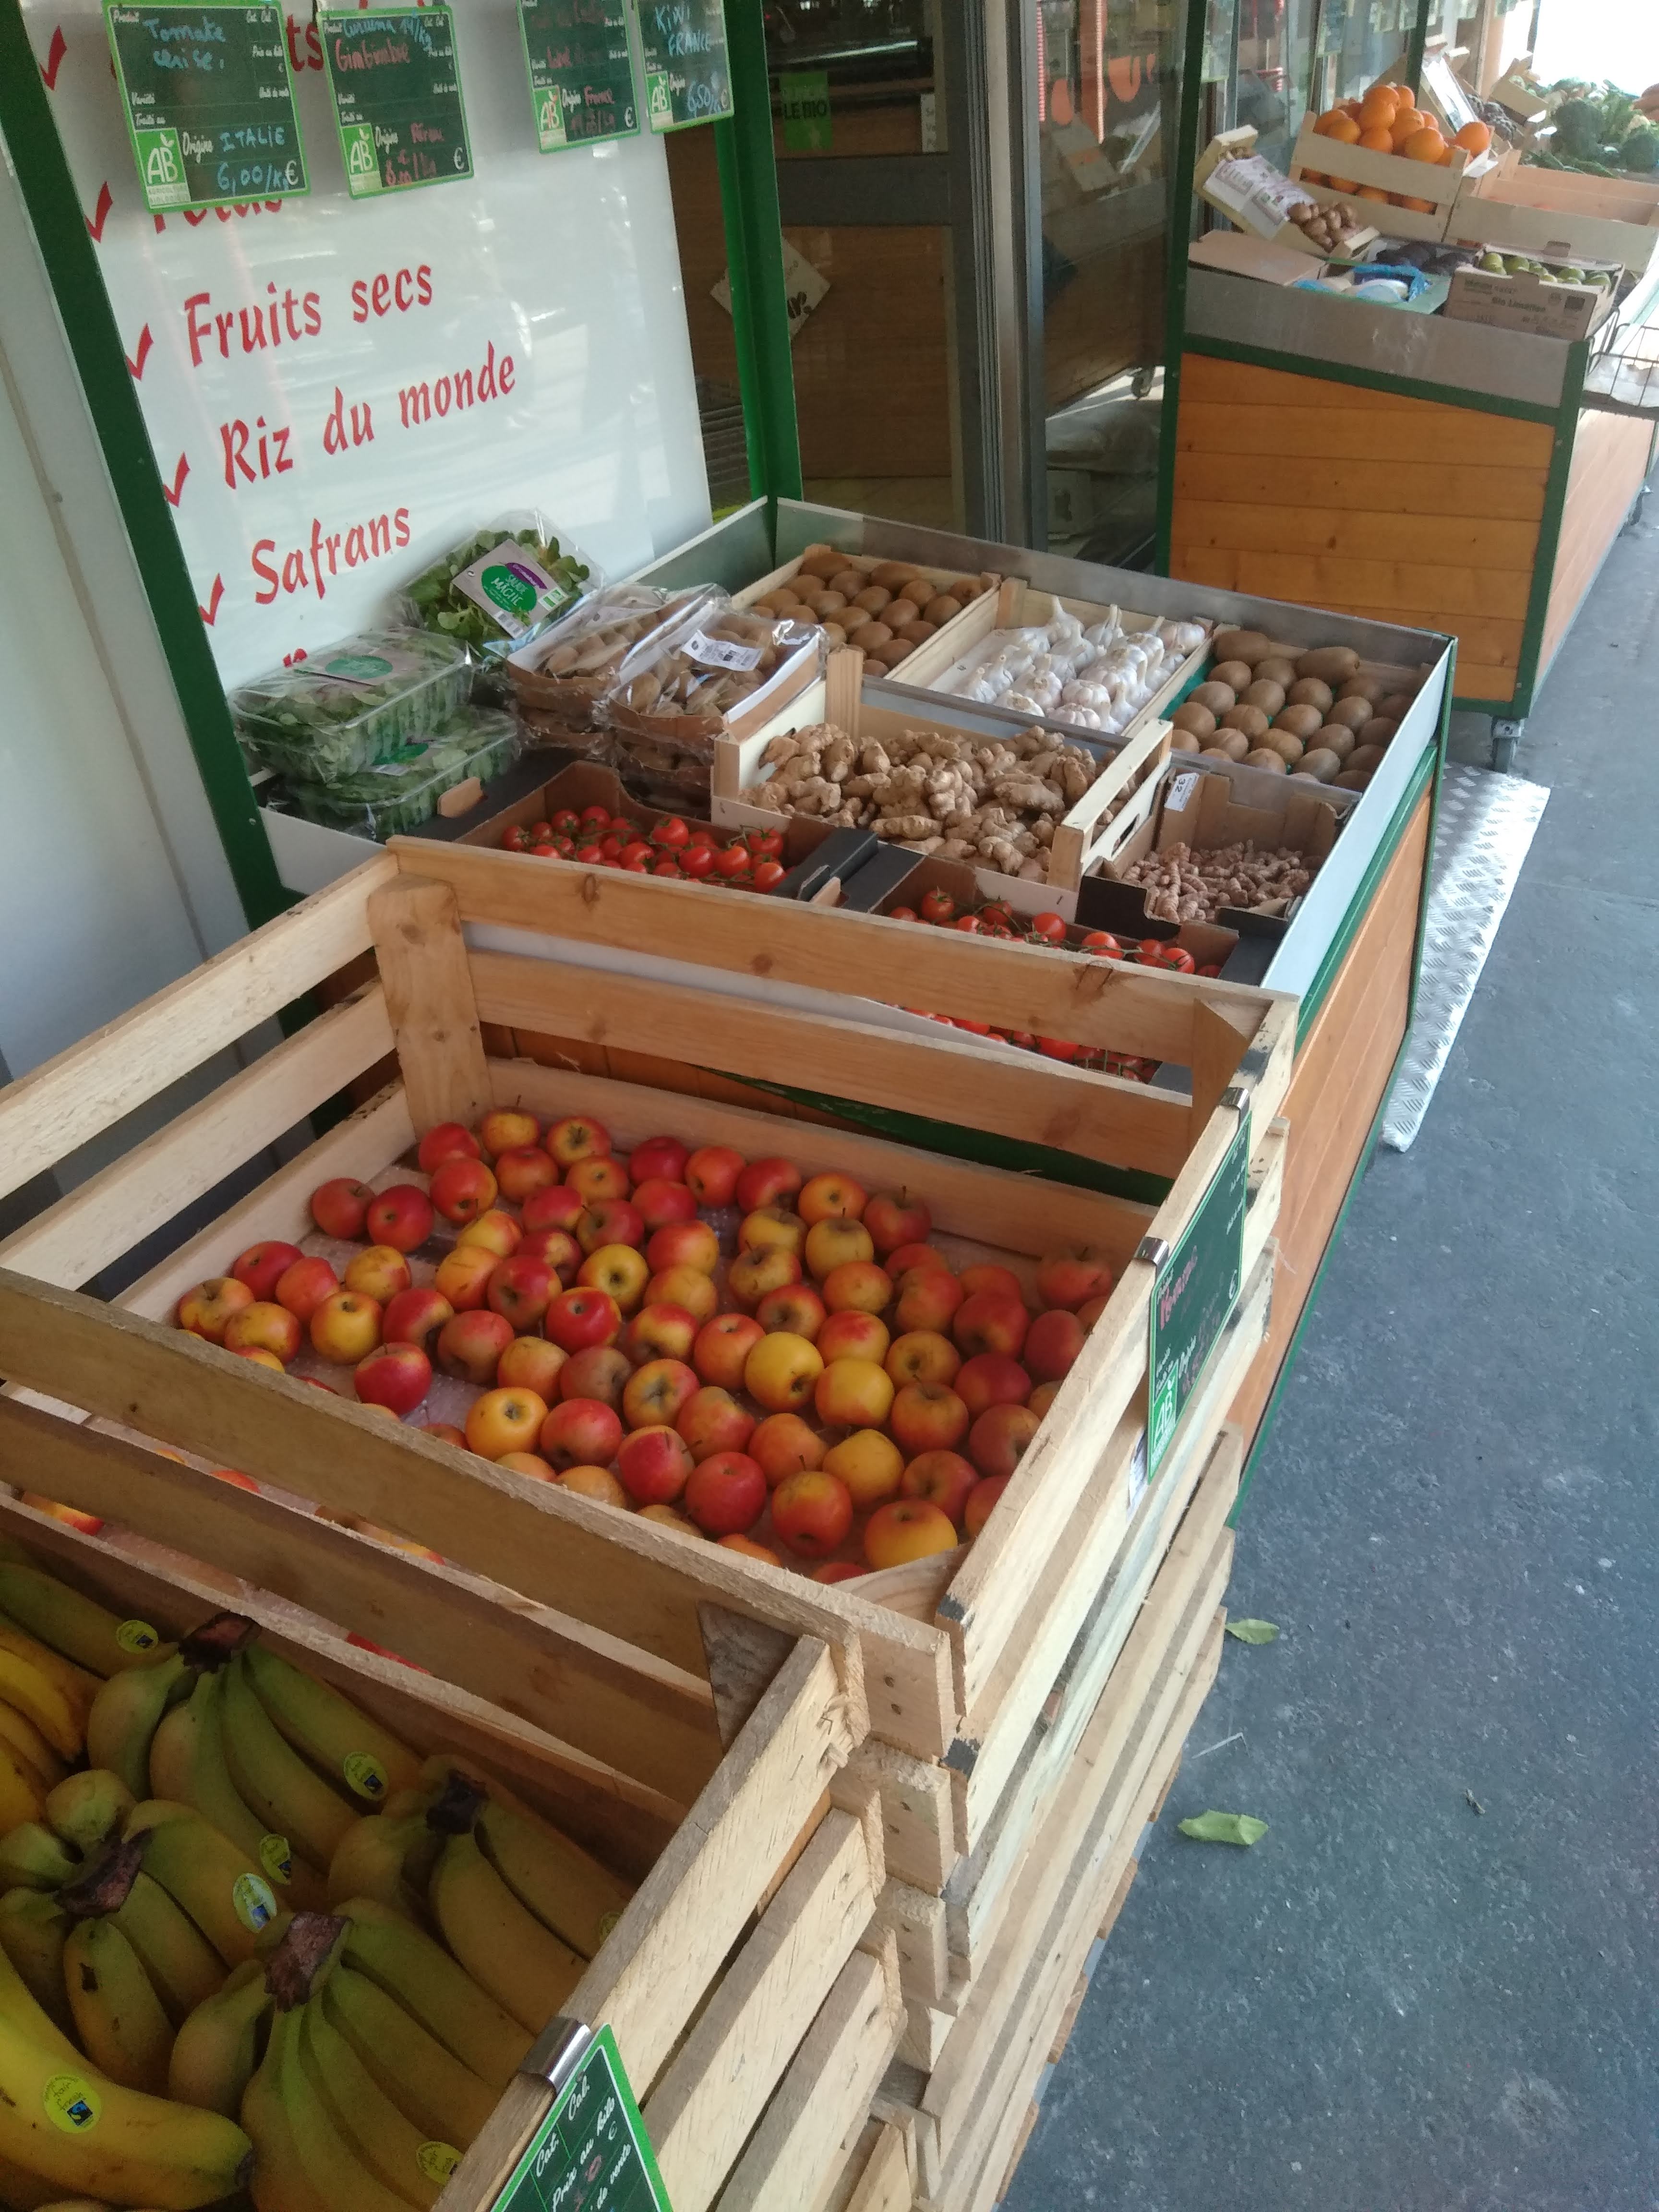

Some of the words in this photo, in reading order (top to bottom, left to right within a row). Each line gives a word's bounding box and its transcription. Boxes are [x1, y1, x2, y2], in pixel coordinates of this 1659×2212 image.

[143, 15, 226, 42] Tomate
[147, 146, 178, 184] AB
[185, 282, 321, 366] Fruits
[351, 264, 432, 323] secs
[220, 416, 293, 489] Riz
[324, 387, 374, 455] du
[399, 341, 515, 427] monde
[252, 507, 409, 604] Safrans
[552, 2167, 577, 2212] Prix
[580, 2138, 594, 2165] au
